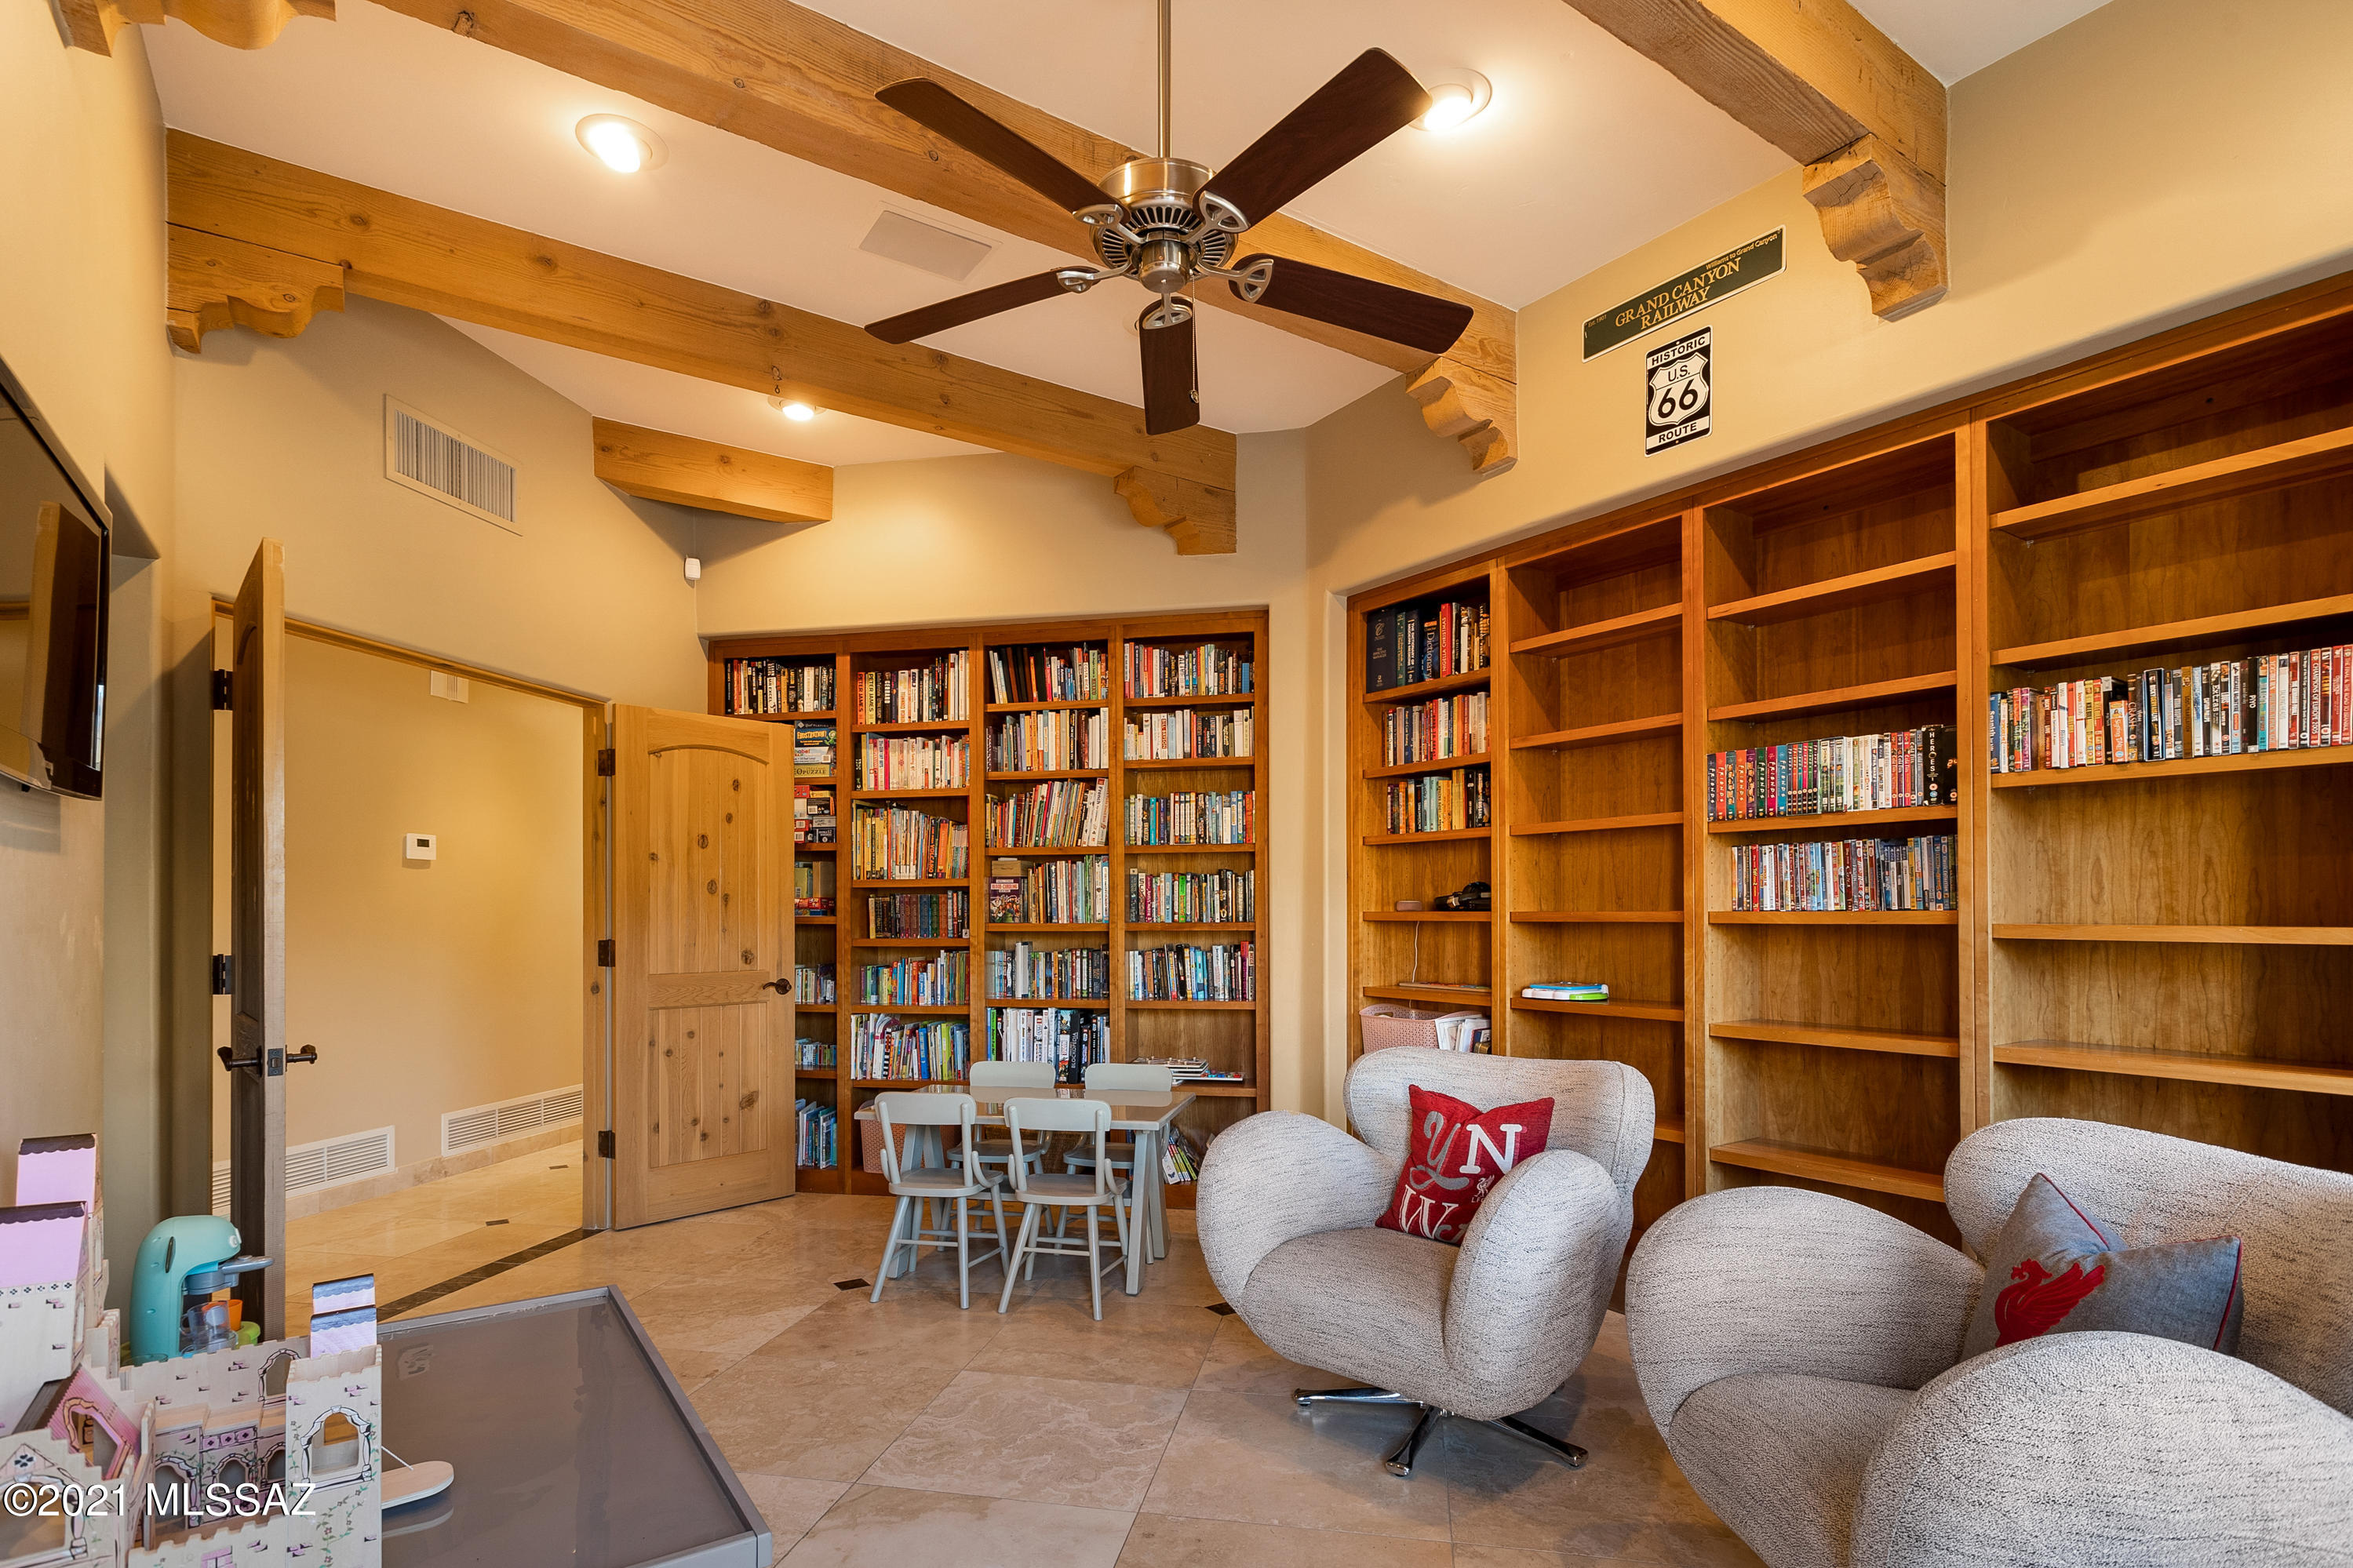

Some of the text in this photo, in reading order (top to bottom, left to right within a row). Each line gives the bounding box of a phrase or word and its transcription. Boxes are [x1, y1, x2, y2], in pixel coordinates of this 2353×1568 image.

[1706, 255, 1729, 269] Williams
[1736, 243, 1754, 256] Grand
[1754, 234, 1777, 248] Canyon
[1615, 257, 1742, 328] GRAND CANYON
[1640, 286, 1710, 329] RAILWAY
[1651, 336, 1705, 366] HISTORIC
[1668, 365, 1690, 382] U.S.
[1658, 379, 1699, 419] 66
[1658, 421, 1697, 443] ROUTE
[1426, 632, 1435, 678] Dictionary
[2322, 675, 2330, 696] KENNY
[2128, 702, 2136, 728] CRASH
[1929, 732, 1937, 772] HEROES
